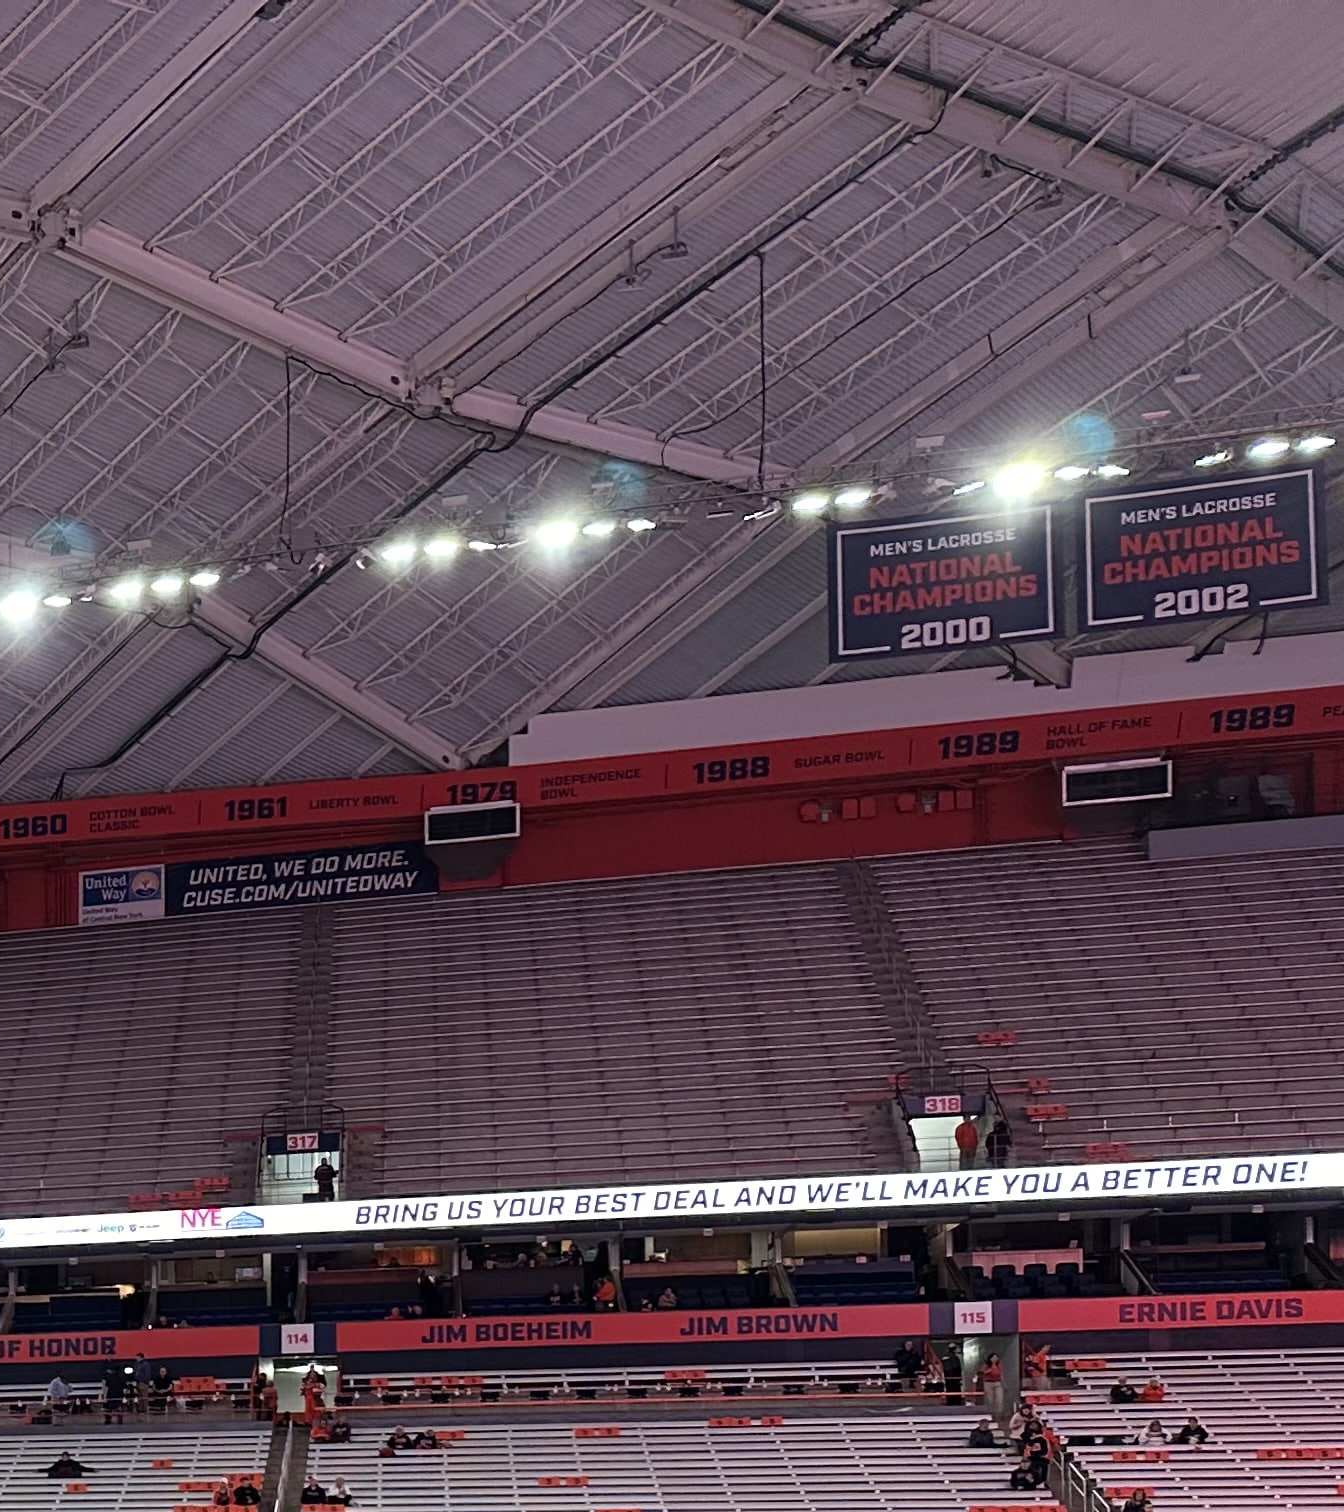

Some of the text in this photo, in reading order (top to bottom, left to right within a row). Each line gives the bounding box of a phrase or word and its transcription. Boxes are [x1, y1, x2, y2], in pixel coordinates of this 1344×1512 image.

[1121, 492, 1277, 526] MEN'S LACROSSE
[870, 527, 1017, 558] MEN'S LACROSSE
[1119, 516, 1283, 557] NATIONAL
[869, 552, 1022, 590] NATIONAL
[1103, 540, 1300, 586] CHAMPIONS
[852, 574, 1038, 616] CHAMPIONS
[1154, 583, 1250, 618] 2002
[901, 615, 991, 649] 2000
[1209, 703, 1296, 733] 1989
[938, 716, 1152, 760] 1989 HALL OF FAME
[1046, 737, 1087, 750] BOWL
[692, 750, 886, 784] 1988 SUGAR BOWL
[446, 768, 641, 804] 1979 INDEPENDENCE
[540, 787, 578, 800] BOWL
[0, 804, 175, 840] 1960 COTTON BOWL
[224, 796, 362, 821] 1961 LIBERTY
[89, 819, 140, 833] CLASSIC
[85, 874, 127, 890] United
[188, 850, 409, 887] UNITED, WE DO MORE.
[101, 888, 127, 902] Way
[182, 870, 419, 908] CUSE.COM/UNITEDWAY
[924, 1096, 961, 1113] 318
[287, 1134, 317, 1150] 317
[97, 1223, 124, 1235] Jeep
[180, 1208, 222, 1229] NYE
[355, 1202, 438, 1225] BRING
[448, 1200, 482, 1220] US
[493, 1196, 566, 1218] YOUR
[575, 1192, 645, 1214] BEST
[654, 1189, 726, 1211] DEAL
[734, 1184, 796, 1208] AND
[806, 1180, 894, 1204] WE'LL
[903, 1176, 991, 1200] MAKE
[1002, 1172, 1063, 1195] YOU
[1071, 1171, 1091, 1192] A
[1101, 1165, 1223, 1191] BETTER
[1233, 1160, 1309, 1186] ONE!
[960, 1298, 1304, 1324] 115 ERNIE DAVIS
[287, 1312, 839, 1345] 114 JIM BOEHEIM JIM BROWN
[29, 1336, 116, 1358] HONOR
